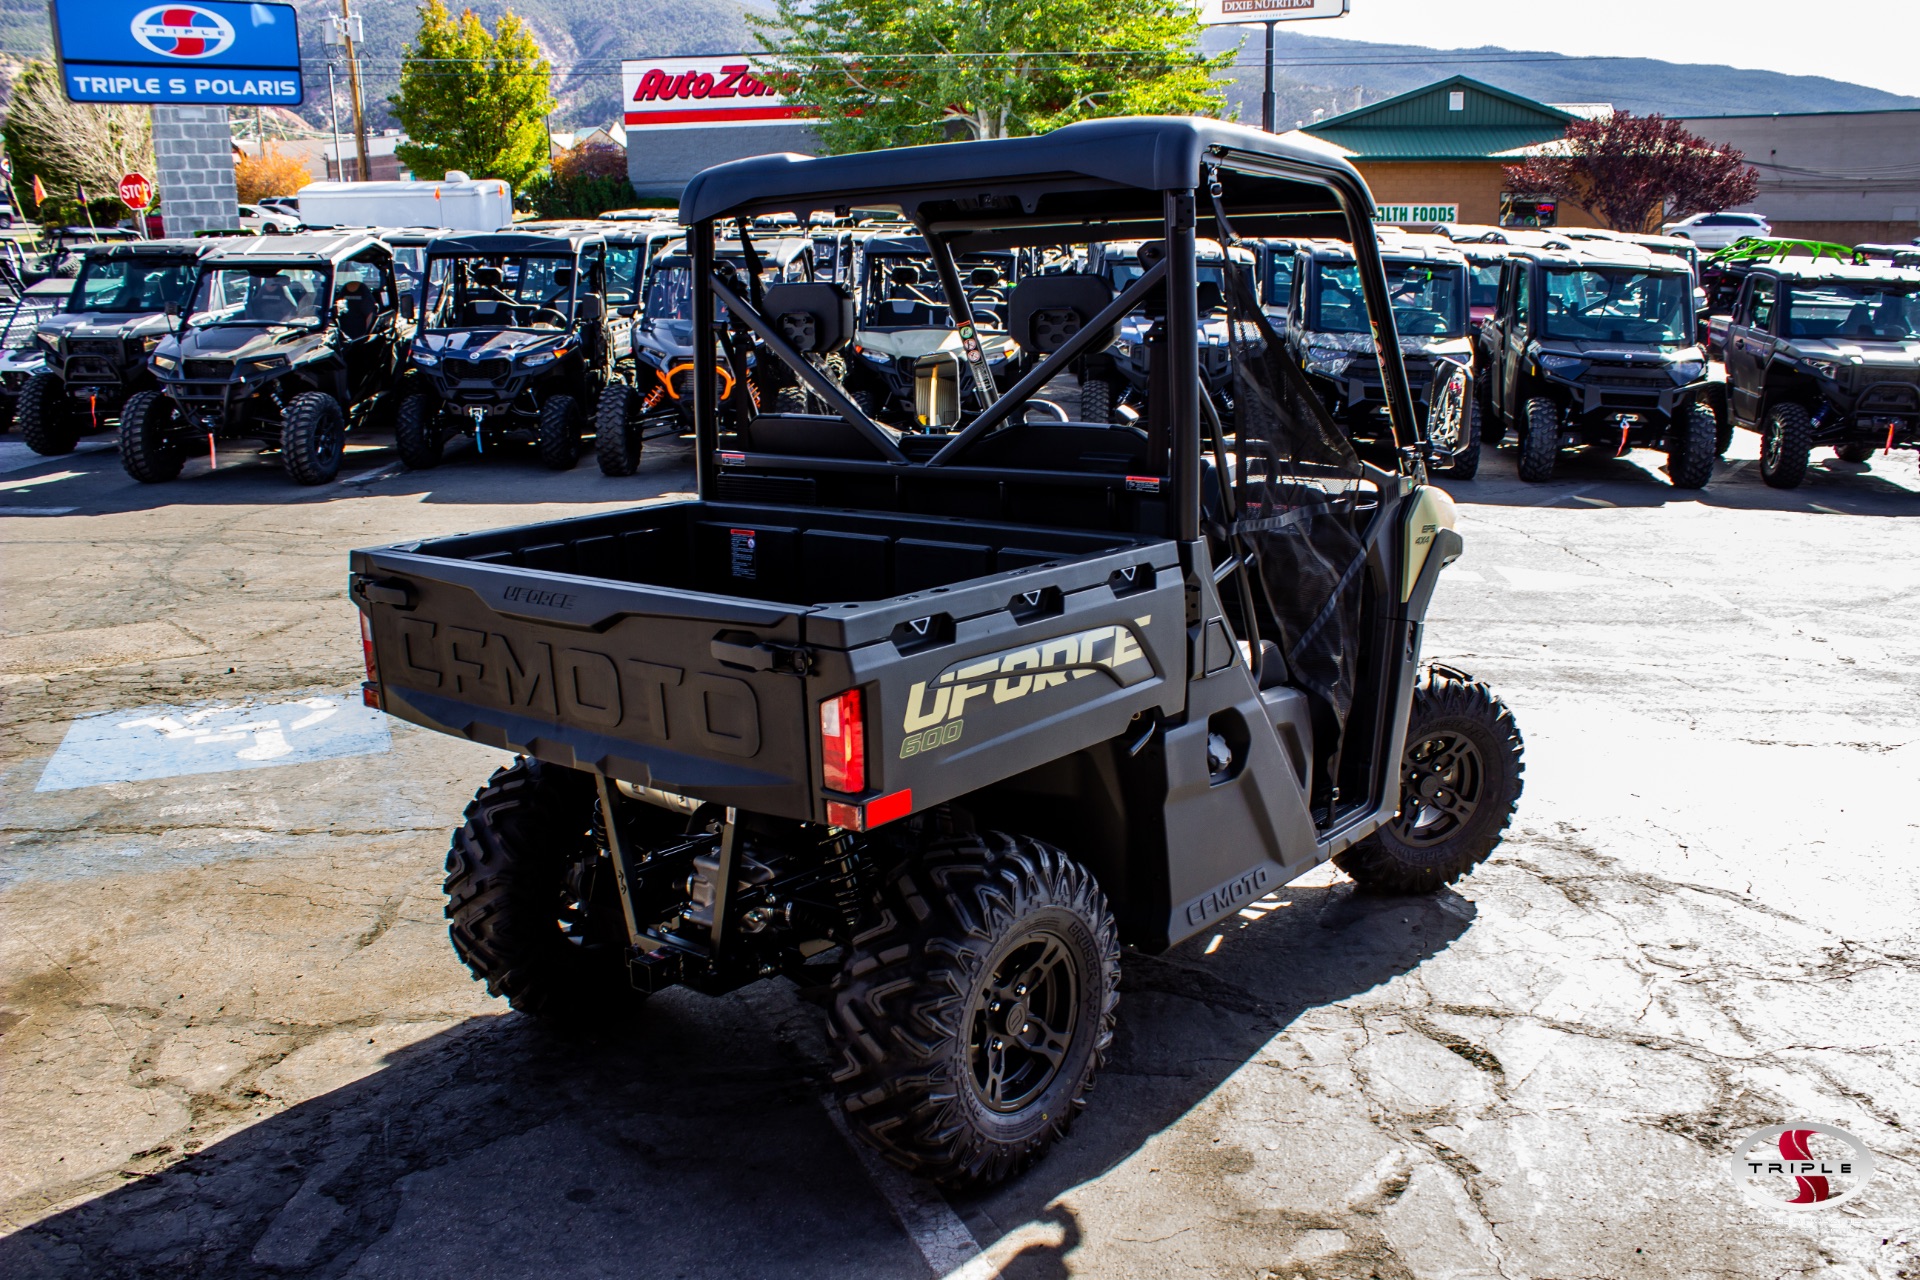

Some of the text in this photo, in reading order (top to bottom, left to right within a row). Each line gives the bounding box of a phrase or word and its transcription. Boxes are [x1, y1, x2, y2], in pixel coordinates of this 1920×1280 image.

[1224, 0, 1312, 11] DIXIE NUTRITION
[139, 26, 226, 37] TRIPLE
[73, 76, 297, 96] TRIPLE S POLARIS
[121, 184, 149, 201] STOP
[1372, 206, 1456, 222] ALTH FOODS
[1421, 524, 1437, 533] EPS
[503, 585, 578, 610] UFORCE
[903, 614, 1152, 734] UFORCE
[400, 616, 761, 758] CFMOTO
[899, 718, 964, 760] 600
[1186, 866, 1268, 926] CFMOTO
